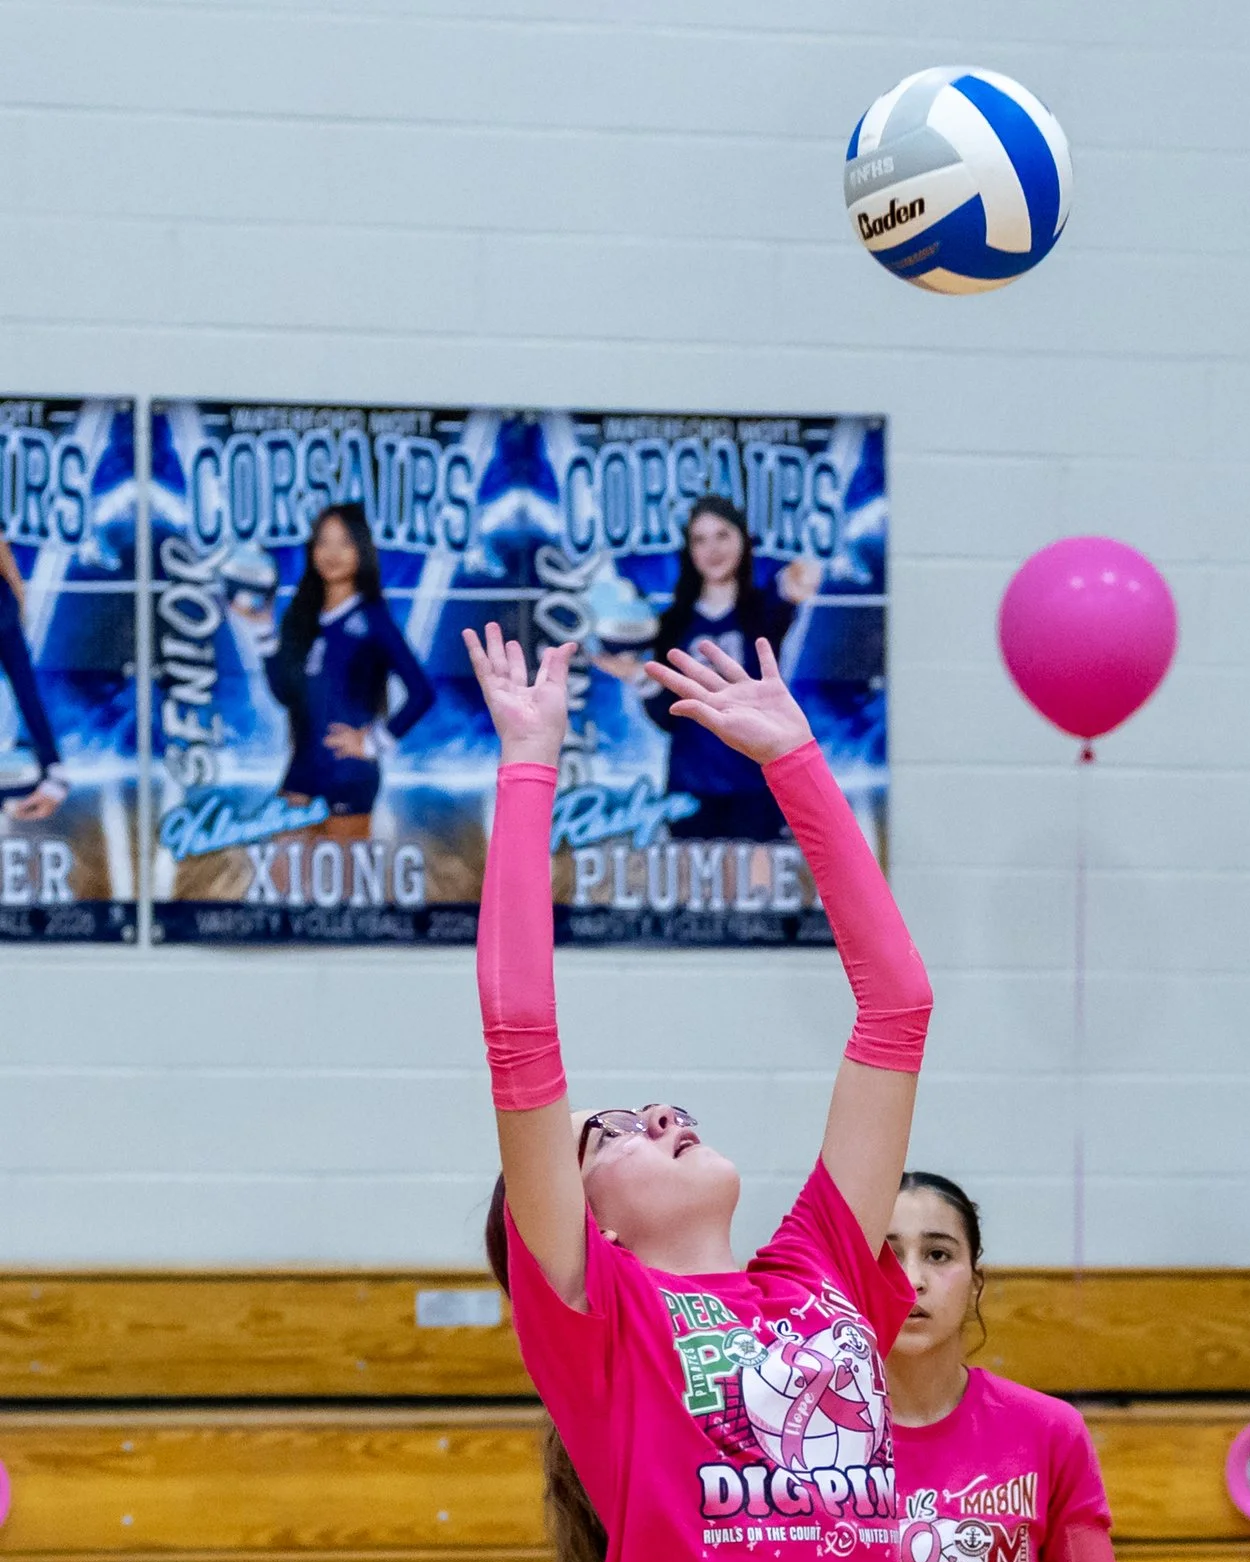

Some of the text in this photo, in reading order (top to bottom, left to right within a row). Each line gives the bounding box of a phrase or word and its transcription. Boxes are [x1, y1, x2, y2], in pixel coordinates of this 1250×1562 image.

[858, 197, 925, 240] Baden
[189, 428, 479, 553] CORSAIRS
[562, 437, 846, 561] CORSAIRS
[159, 536, 226, 788] SENIOR
[1, 837, 75, 905] ER
[245, 838, 427, 909] XIONG
[572, 840, 824, 913] PLUMLE
[674, 1330, 741, 1416] P
[683, 1347, 707, 1397] PIRATES
[784, 1392, 815, 1436] Hope
[697, 1463, 814, 1519] DIG
[906, 1489, 937, 1519] VS
[961, 1472, 1038, 1521] MASON
[703, 1525, 825, 1544] RIVALS ON THE COURT.
[859, 1528, 889, 1544] UNITED
